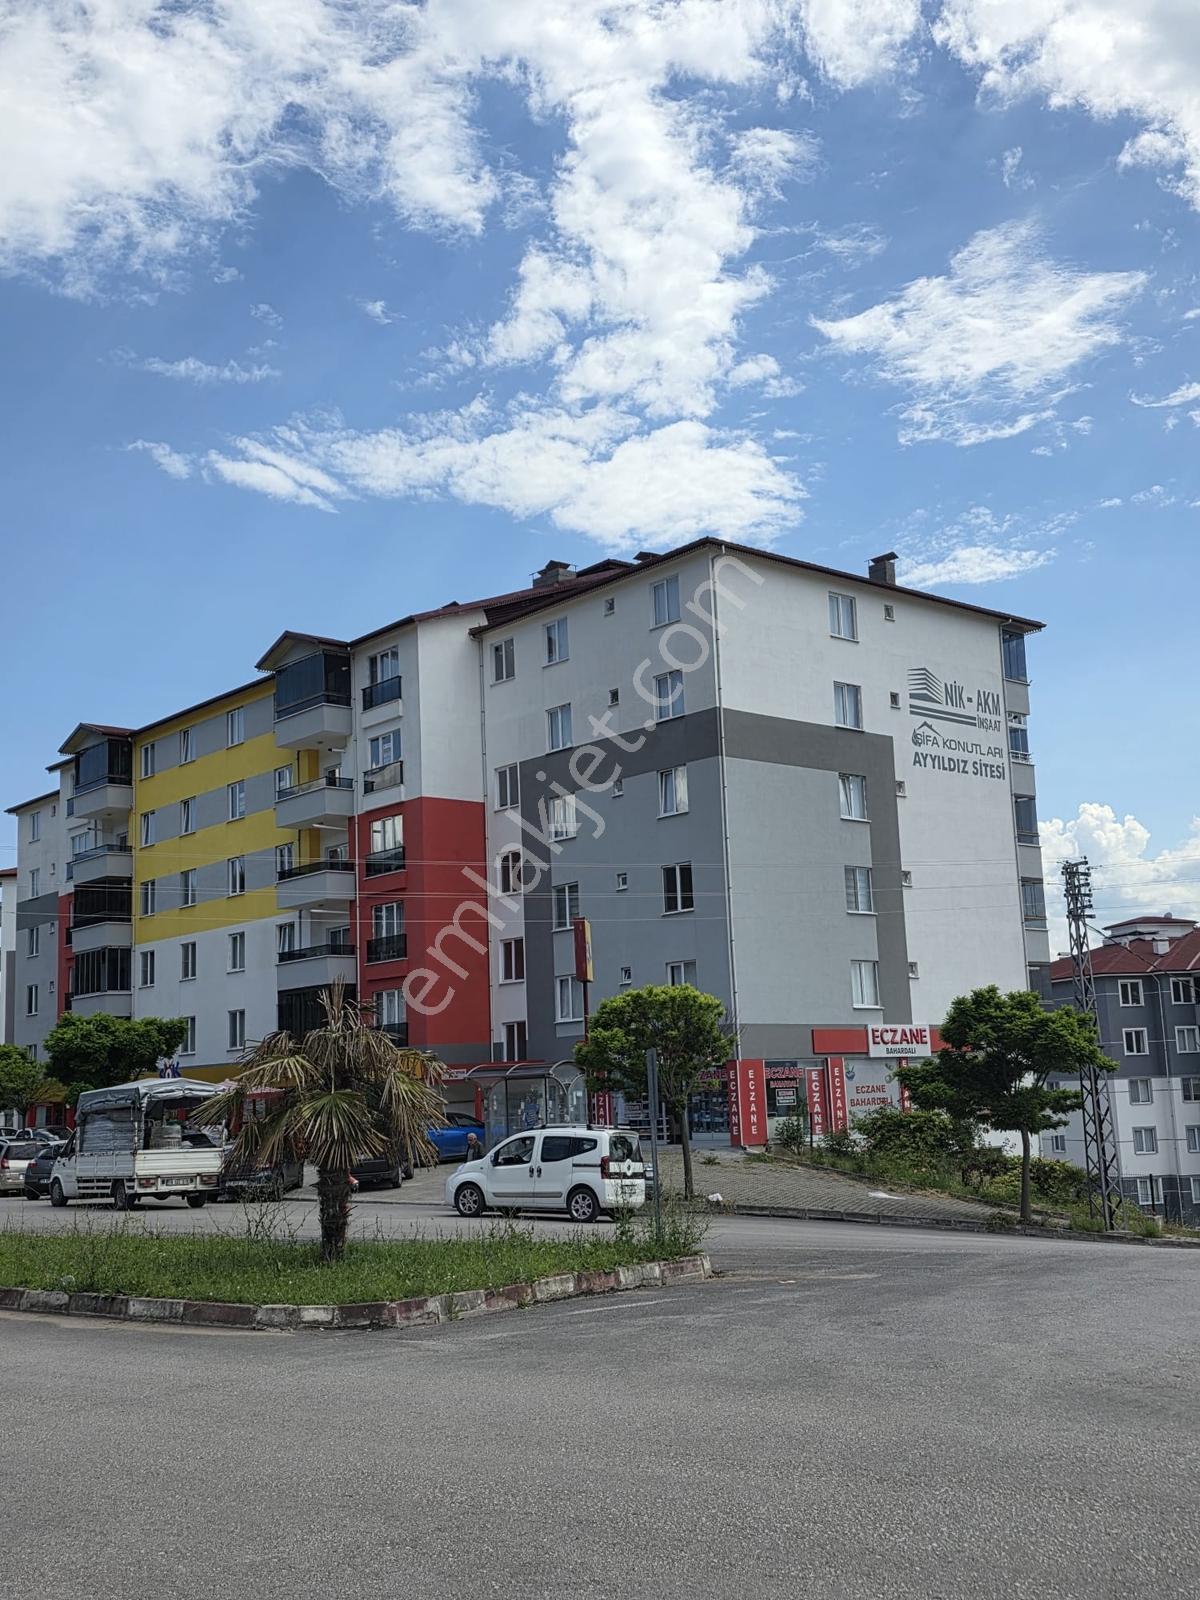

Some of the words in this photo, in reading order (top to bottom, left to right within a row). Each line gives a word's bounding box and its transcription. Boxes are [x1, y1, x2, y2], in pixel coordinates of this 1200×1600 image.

[942, 737, 1004, 759] KONUTLARI
[912, 751, 969, 775] AYYILDIZ
[972, 758, 1006, 781] SİTESİ
[871, 1028, 928, 1045] ECZANE
[729, 1070, 740, 1135] ECZANE
[747, 1069, 758, 1135] ECZANE
[811, 1071, 823, 1134] ECZANE
[855, 1084, 887, 1094] ECZANE
